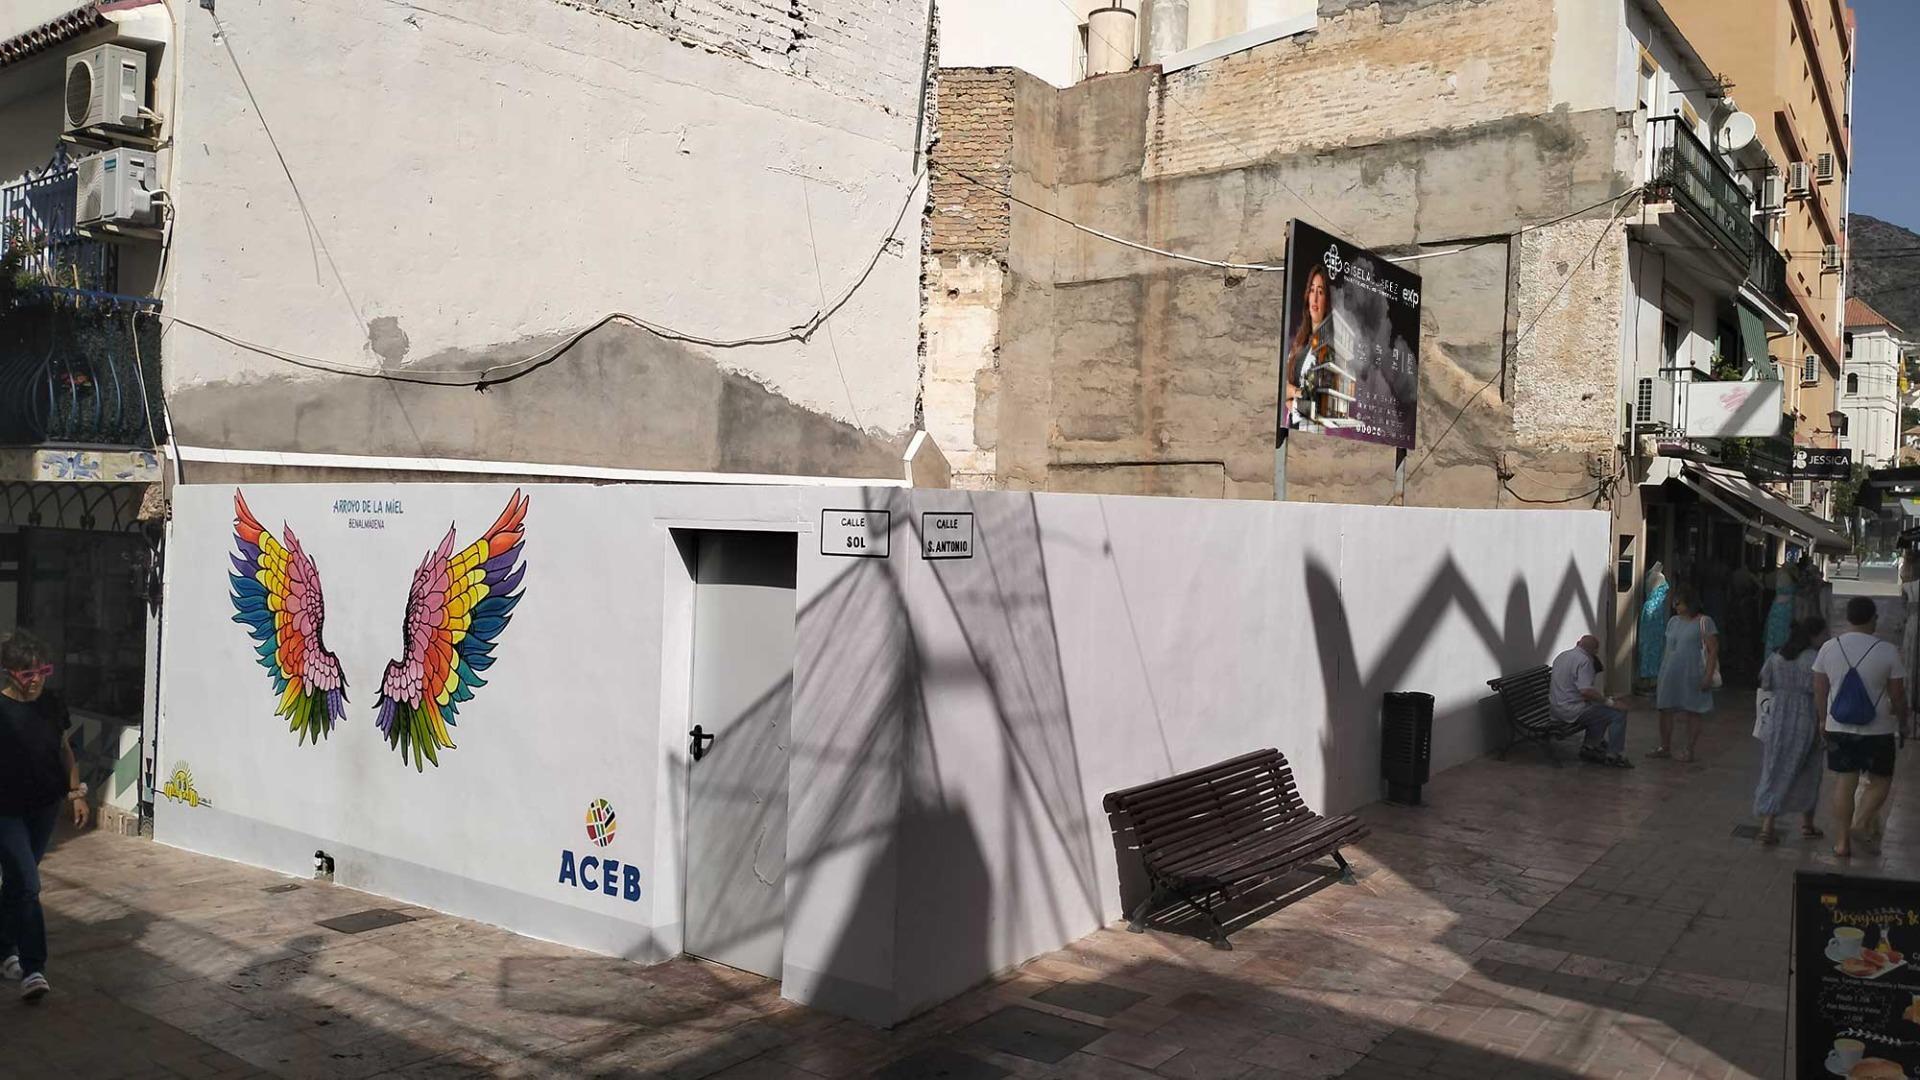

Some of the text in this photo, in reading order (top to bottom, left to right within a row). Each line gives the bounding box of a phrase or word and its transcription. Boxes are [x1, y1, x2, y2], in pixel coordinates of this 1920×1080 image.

[1808, 455, 1848, 465] JESSICA
[333, 500, 360, 513] ARROYO
[362, 500, 372, 513] DE
[373, 501, 383, 514] LA
[840, 518, 865, 527] CALLE
[936, 519, 958, 529] CALLE
[846, 536, 866, 548] SOL
[558, 849, 642, 903] ACEB
